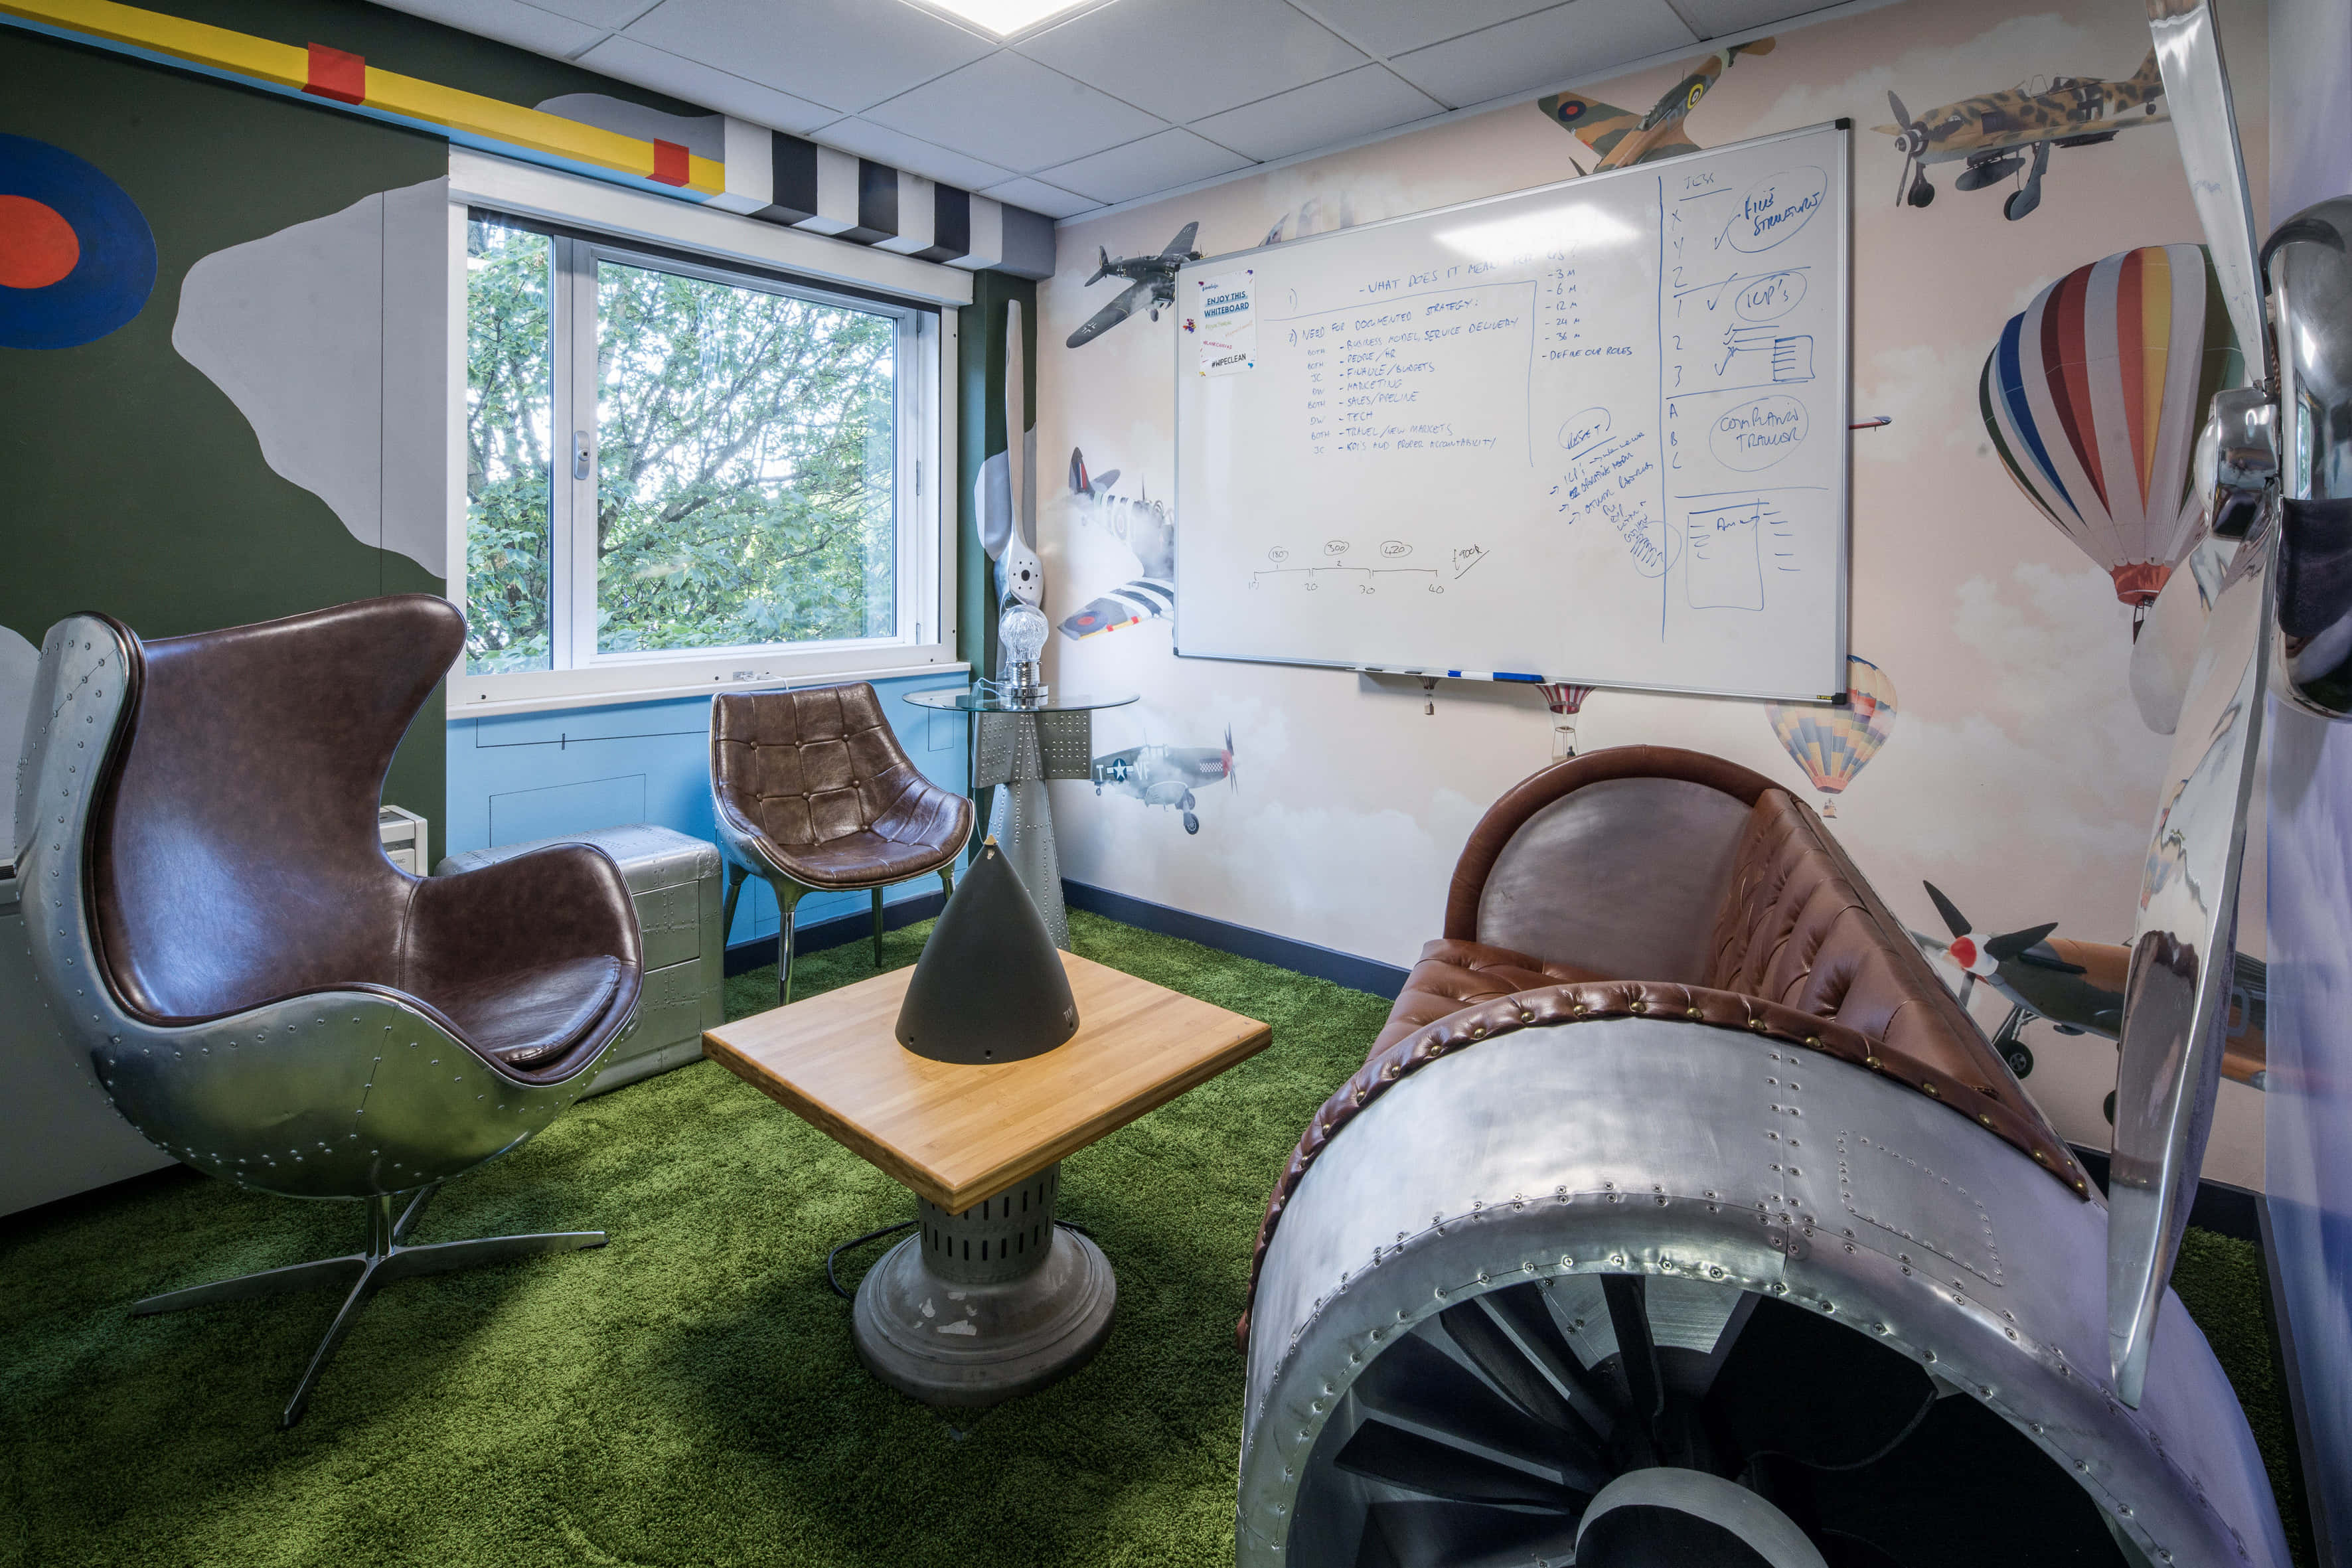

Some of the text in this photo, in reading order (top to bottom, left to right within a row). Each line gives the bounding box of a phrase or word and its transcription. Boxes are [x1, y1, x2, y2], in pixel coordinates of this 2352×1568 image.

[1207, 291, 1245, 305] ENJOY THIS
[1204, 302, 1249, 317] WHITEBOARD
[1211, 353, 1246, 368] #WIPECLEAN
[1326, 544, 1346, 553] 300
[1383, 544, 1406, 554] 420
